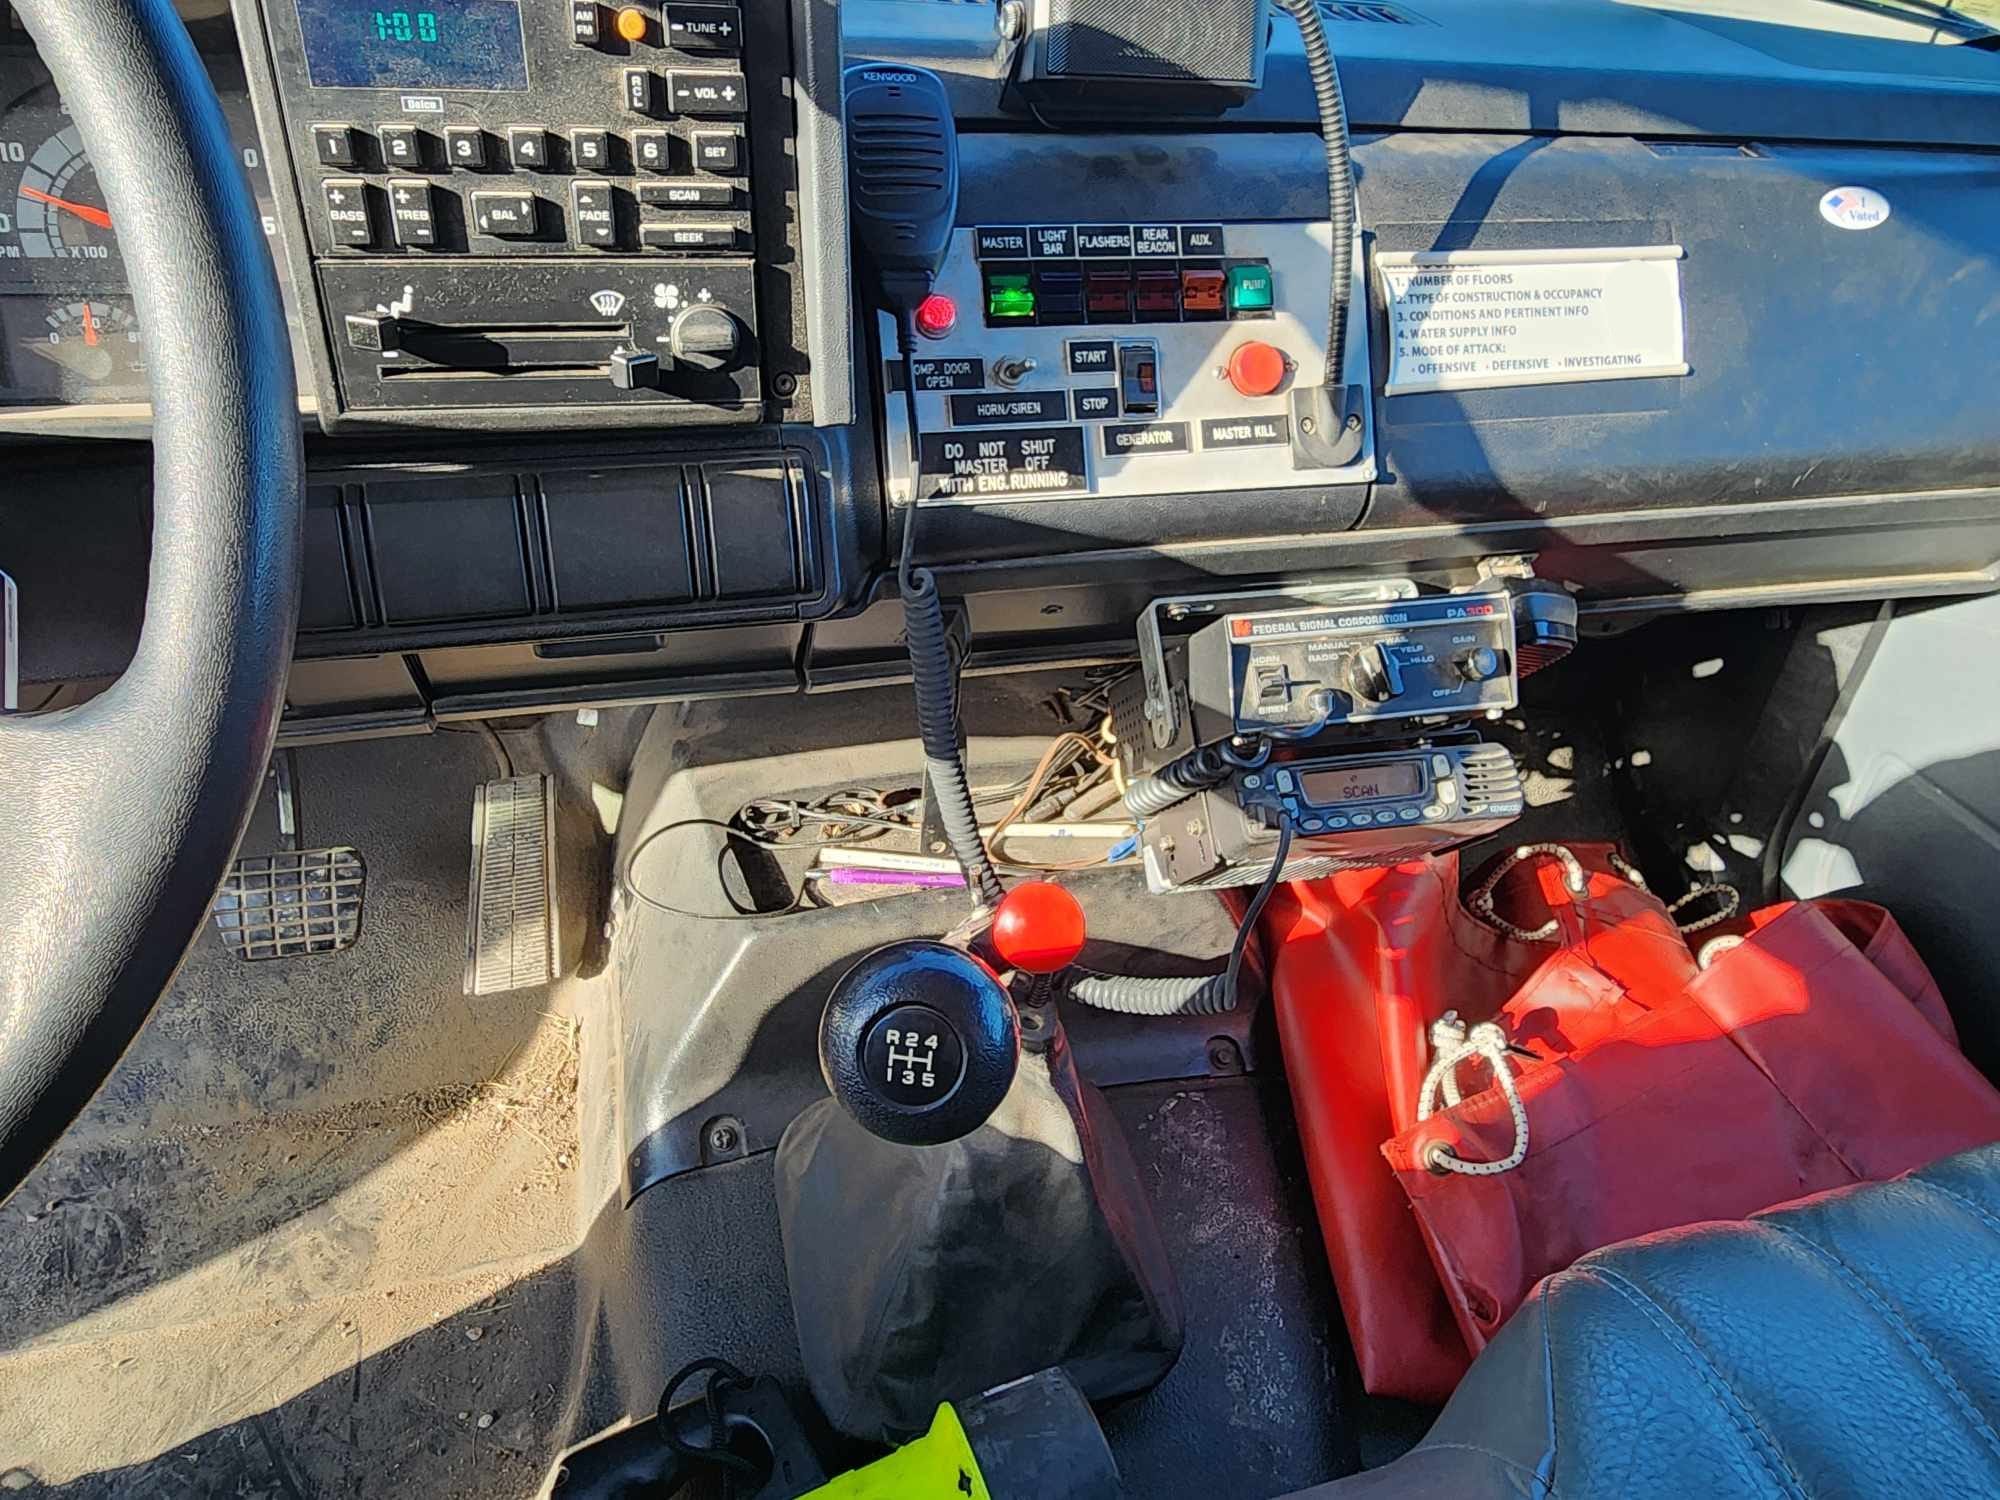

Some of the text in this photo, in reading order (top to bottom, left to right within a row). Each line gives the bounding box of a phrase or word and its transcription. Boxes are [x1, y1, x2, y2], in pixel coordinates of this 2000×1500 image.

[575, 11, 593, 21] AM
[376, 12, 437, 41] 1:00
[576, 25, 594, 35] FM
[686, 22, 717, 33] TUNE
[863, 72, 917, 82] KENWOOD
[694, 87, 718, 99] VOL
[329, 139, 338, 155] 1
[391, 140, 408, 156] 2
[456, 140, 472, 156] 3
[520, 140, 535, 157] 4
[582, 142, 598, 158] 5
[643, 142, 658, 158] 6
[704, 147, 727, 158] SET
[669, 190, 700, 201] SCAN
[330, 210, 366, 222] BASS
[396, 209, 430, 221] TREB
[491, 209, 518, 221] BAL
[579, 210, 610, 221] FADE
[674, 232, 704, 243] SEEK
[1038, 230, 1067, 242] LIGHT
[1142, 228, 1169, 240] REAR
[1190, 233, 1213, 246] AUX.
[982, 236, 1024, 249] MASTER
[1079, 235, 1130, 248] FLASHERS
[1137, 241, 1176, 253] BEACON
[1043, 243, 1064, 255] BAR
[1243, 279, 1266, 289] PUMP
[1408, 274, 1454, 287] NUMBER
[1456, 274, 1470, 285] OF
[1472, 273, 1514, 285] FLOORS
[1408, 294, 1434, 304] TYPE
[1435, 293, 1450, 303] OF
[1452, 290, 1532, 303] CONSTRUCTION
[1534, 290, 1541, 300] &
[1543, 288, 1603, 300] OCCUPANCY
[1397, 305, 1589, 322] 3. CONDITIONS AND PERTINENT INFO
[1398, 325, 1517, 340] 4. WATER SUPPLY INFO
[1075, 350, 1107, 363] START
[1399, 343, 1506, 357] 5. MODE OF ATTACK:
[911, 362, 972, 375] OMP. DOOR
[1418, 354, 1642, 375] OFFENSIVE DEFENSIVE INVESTIGATING
[926, 376, 954, 388] OPEN
[977, 402, 1041, 416] HORN/SIREN
[1082, 397, 1109, 410] STOP
[1212, 424, 1277, 440] MASTER KILL
[1116, 432, 1173, 446] GENERATOR
[944, 438, 1056, 459] DO NOT SHUT
[954, 455, 1050, 475] MASTER OFF
[939, 475, 974, 493] WITH
[1447, 604, 1494, 619] PA300
[1252, 613, 1408, 636] FEDERAL SIGNAL CORPORATION
[1452, 634, 1476, 644] GAIN
[1308, 641, 1350, 652] MANUAL
[1251, 655, 1280, 665] HORN
[1308, 653, 1340, 663] RADIO
[1258, 704, 1289, 715] SIREN
[1343, 784, 1380, 799] SCAN
[886, 1029, 938, 1050] R 2 4
[901, 1070, 915, 1085] 3
[921, 1072, 935, 1088] 5
